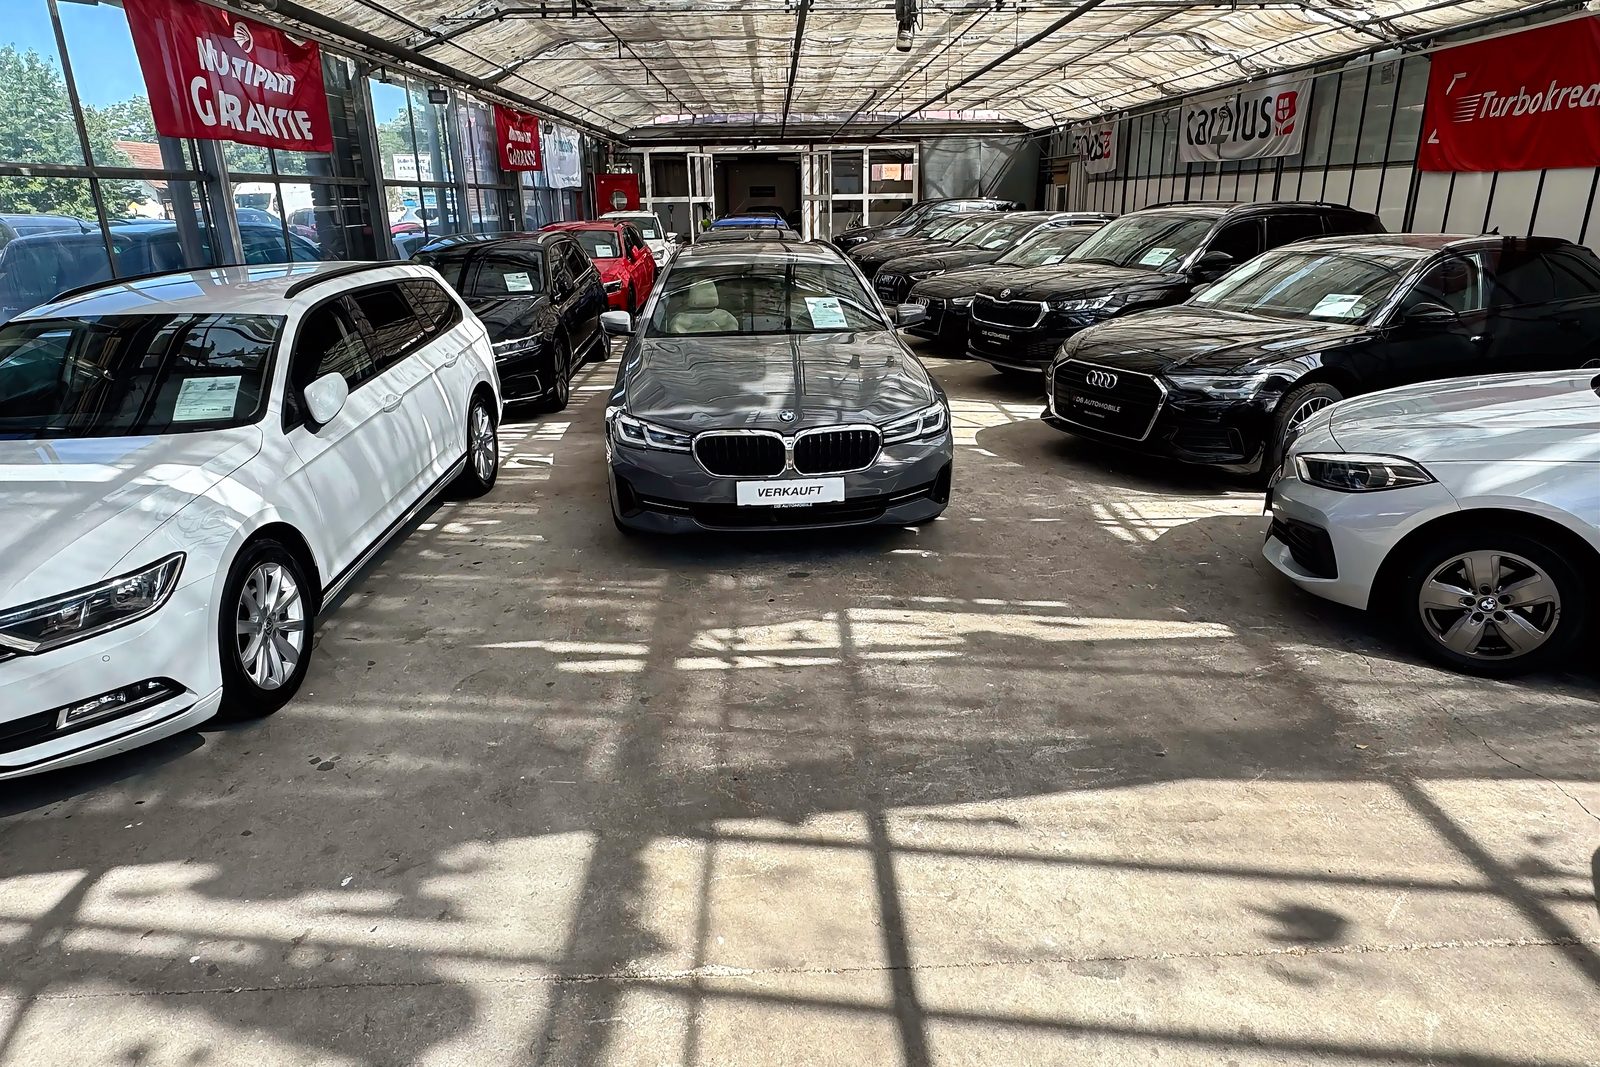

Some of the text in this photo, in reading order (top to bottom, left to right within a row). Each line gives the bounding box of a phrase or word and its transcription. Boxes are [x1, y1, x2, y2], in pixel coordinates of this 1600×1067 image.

[196, 36, 296, 96] MUTIPART
[1479, 79, 1600, 119] Turbokred
[1084, 398, 1121, 413] AUTOMOBILE
[757, 485, 824, 498] VERKAUFT
